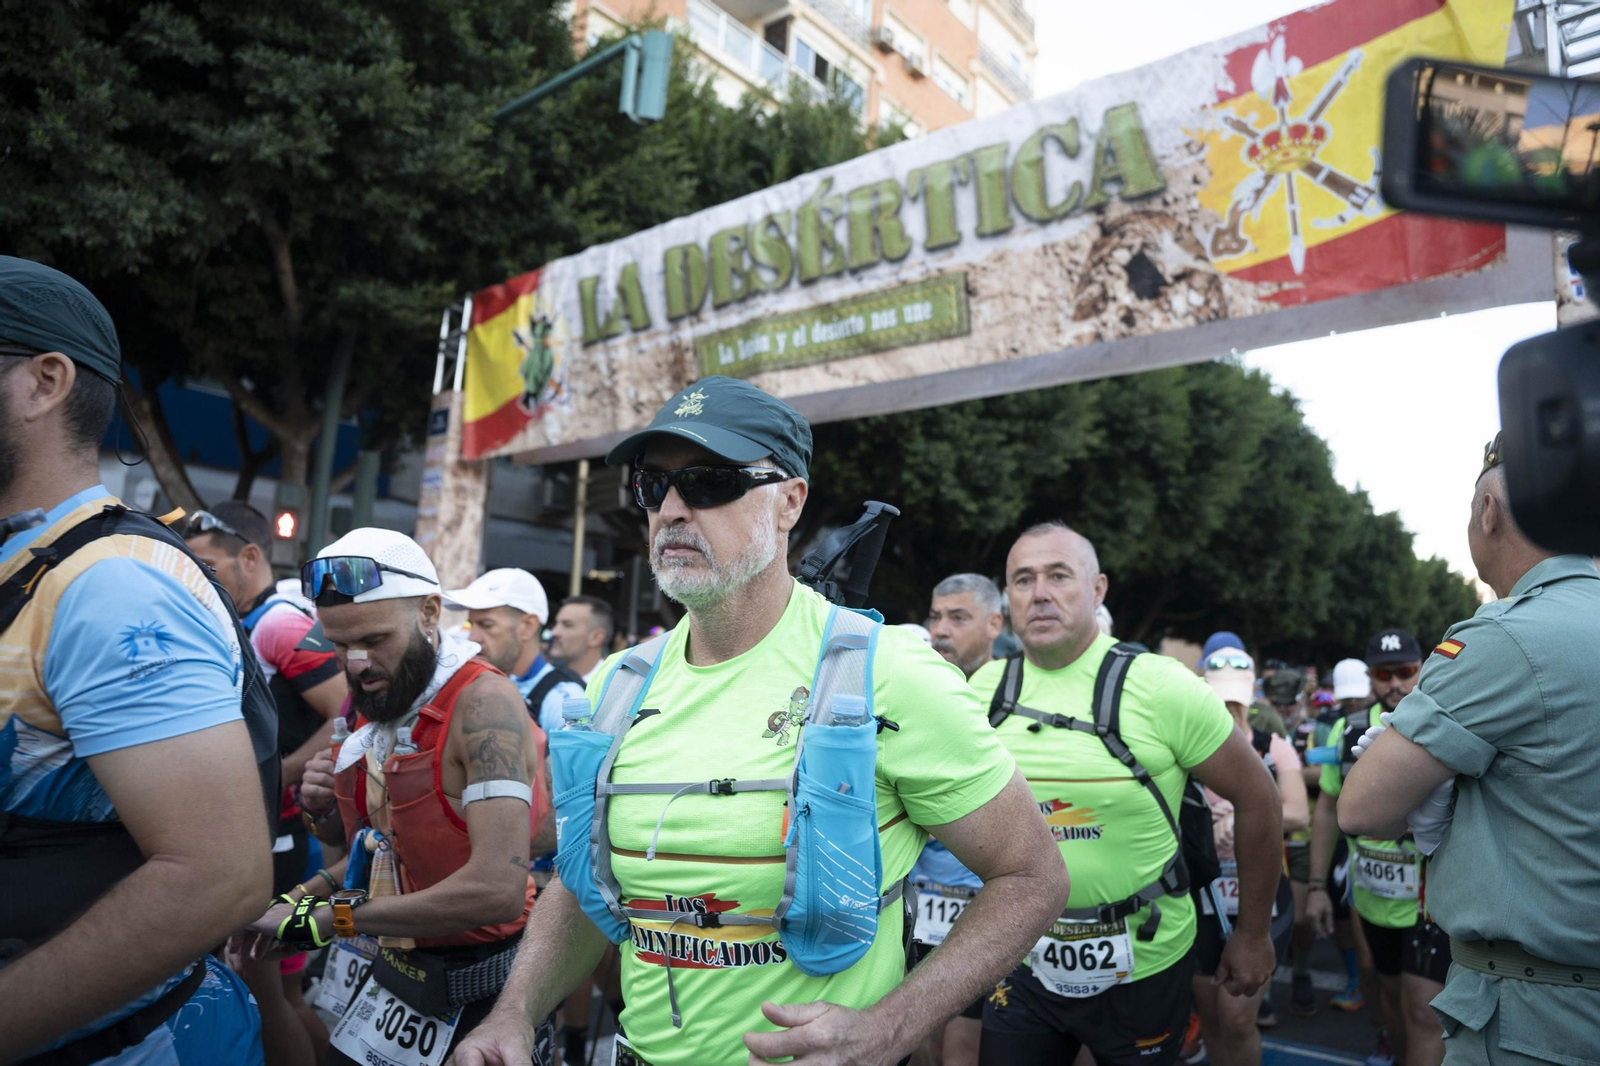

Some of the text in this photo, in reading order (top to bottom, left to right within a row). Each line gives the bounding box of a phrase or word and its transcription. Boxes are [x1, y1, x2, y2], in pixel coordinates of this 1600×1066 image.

[578, 102, 1166, 347] LA DESÉRTICA
[776, 332, 788, 354] y
[792, 324, 807, 348] el
[811, 314, 866, 344] desierto
[871, 308, 898, 331] nos
[902, 301, 933, 324] une
[1364, 861, 1405, 882] 4061
[294, 895, 315, 928] LEKI
[664, 894, 707, 913] LOS
[925, 898, 967, 924] 112
[1043, 940, 1117, 972] 4062
[375, 997, 438, 1058] 3050
[365, 1050, 396, 1066] asis
